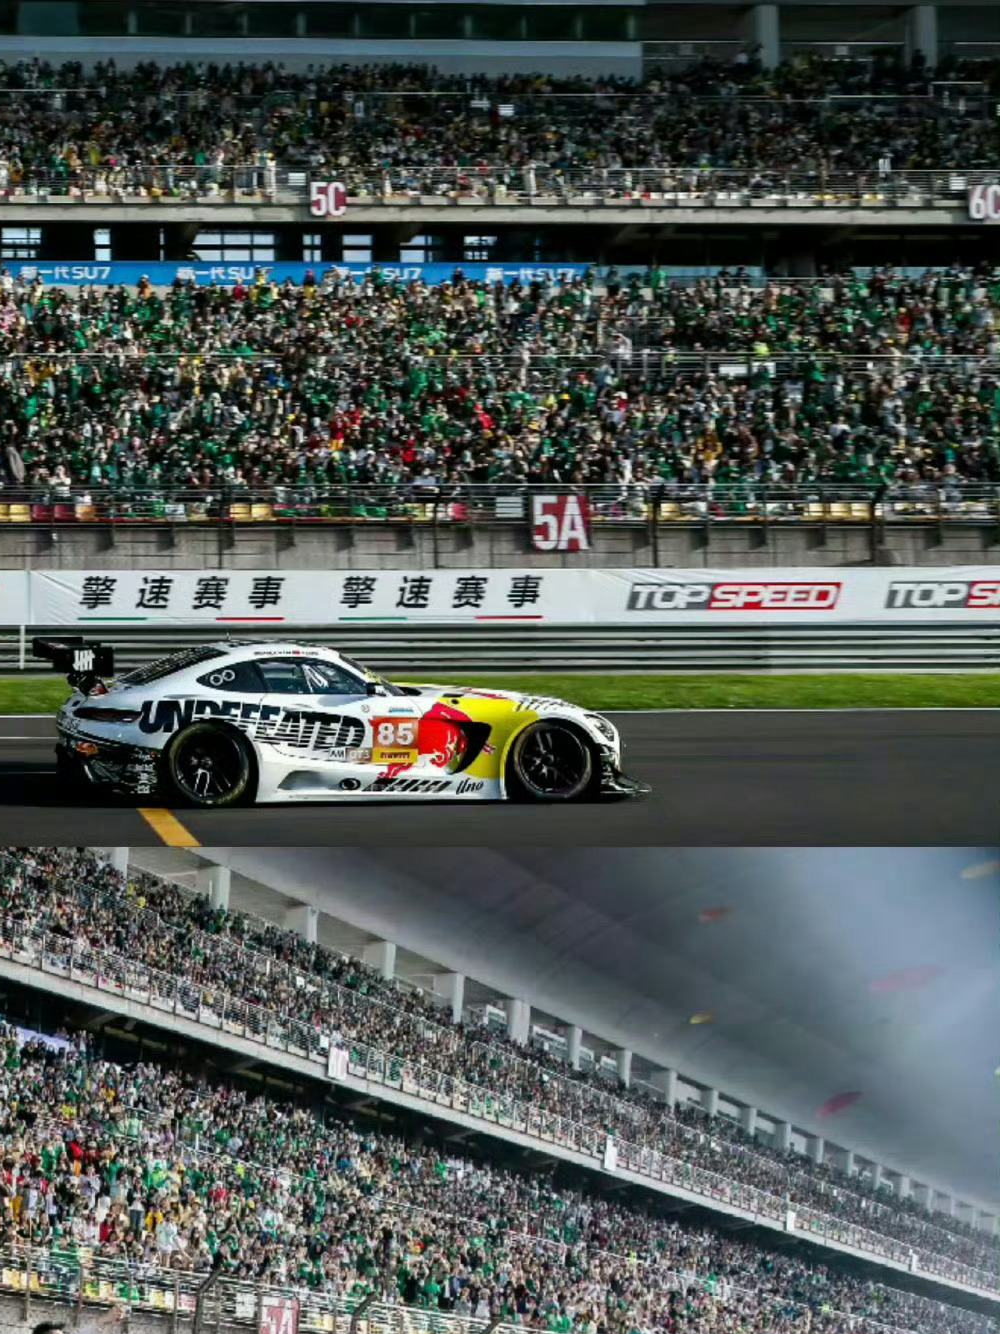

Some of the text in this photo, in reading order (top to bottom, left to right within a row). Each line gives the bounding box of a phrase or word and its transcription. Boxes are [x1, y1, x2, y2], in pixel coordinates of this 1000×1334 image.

[310, 182, 346, 216] 5C
[533, 494, 587, 551] 5A
[78, 575, 286, 610] 擎速赛事
[340, 574, 544, 609] 擎速赛事
[631, 583, 839, 610] TOP SPEED
[889, 582, 968, 608] TOP
[377, 722, 415, 746] 85
